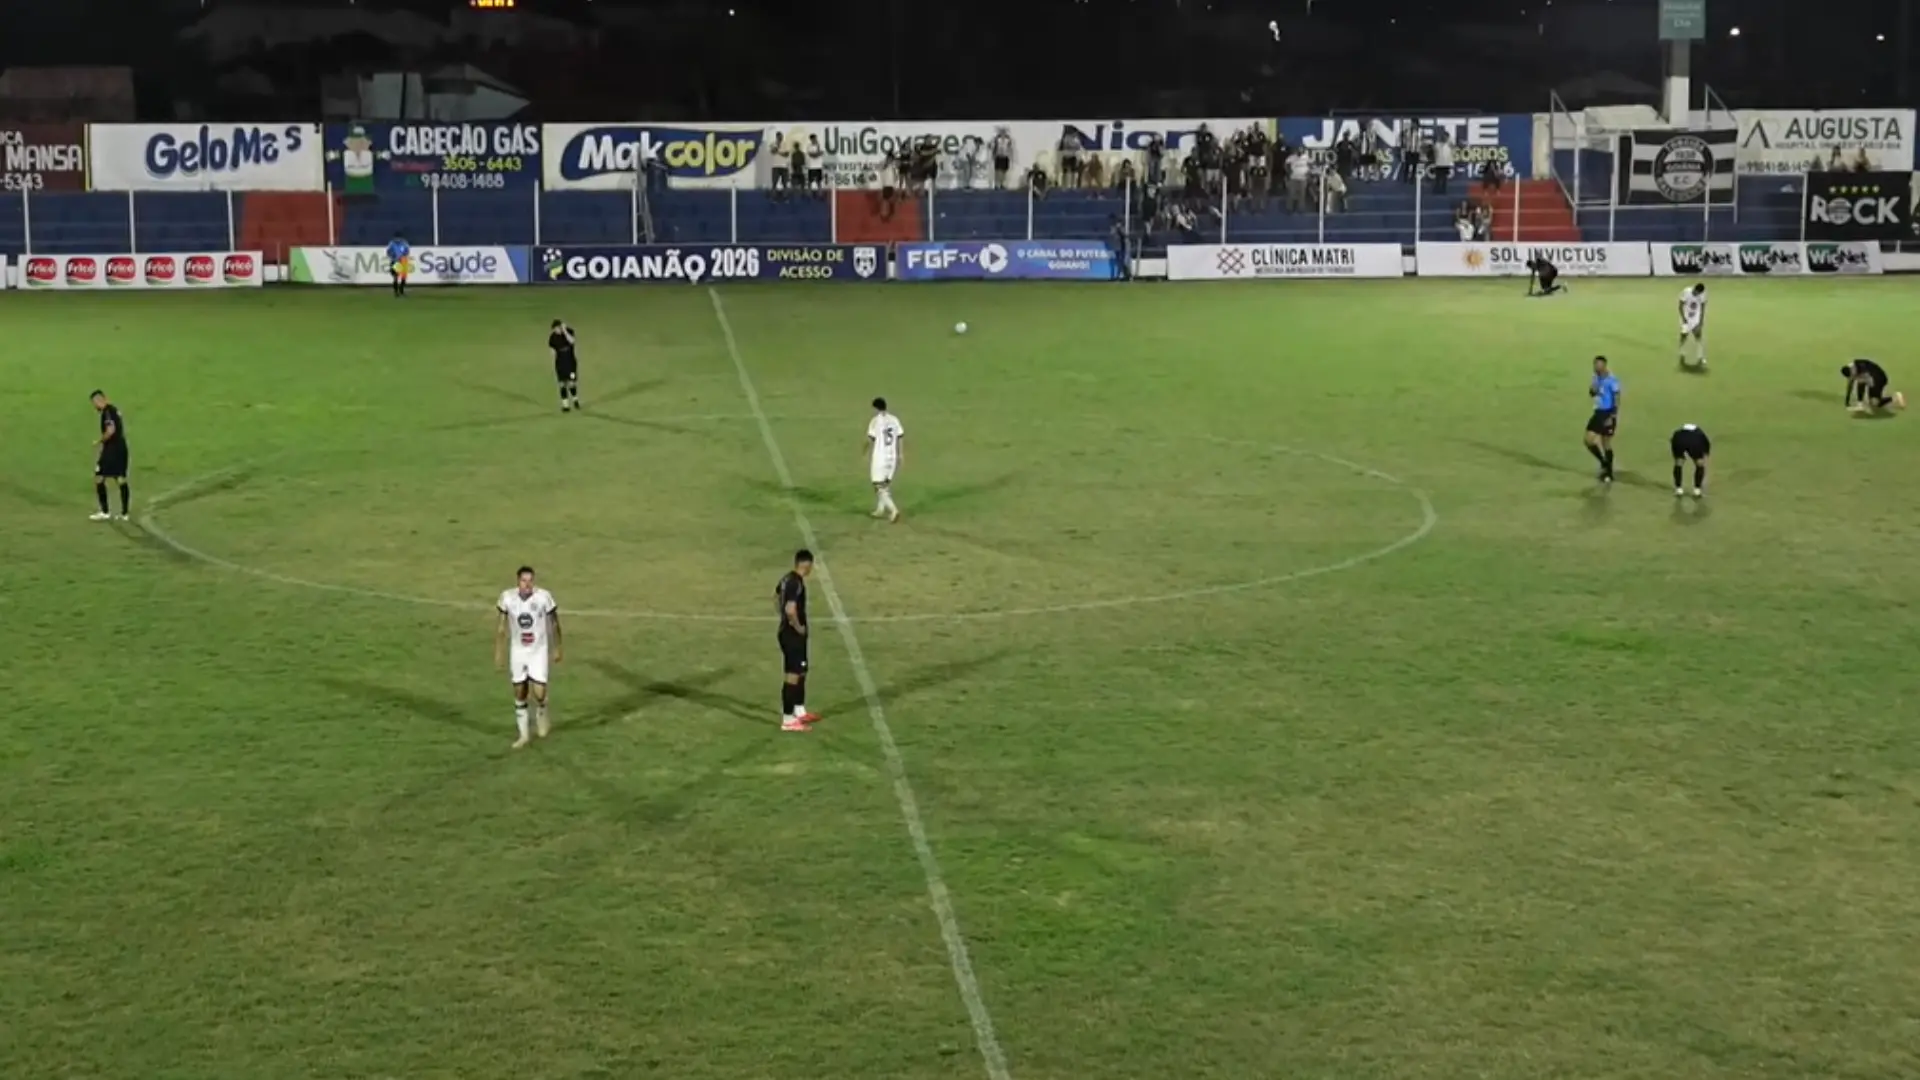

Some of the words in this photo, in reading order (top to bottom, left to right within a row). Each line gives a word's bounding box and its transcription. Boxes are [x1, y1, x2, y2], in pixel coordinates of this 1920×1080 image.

[1302, 117, 1499, 148] JANETE
[1784, 117, 1902, 141] AUGUSTA
[5, 144, 83, 171] MANSA
[419, 250, 497, 274] Saúde
[826, 249, 844, 262] DE
[907, 250, 959, 269] FGF
[1311, 247, 1355, 265] MATRI
[1490, 247, 1522, 263] SOL
[1528, 247, 1607, 262] INVICTUS
[566, 249, 706, 285] GOIANÃO
[710, 247, 760, 278] 2026
[779, 265, 833, 279] ACESSO
